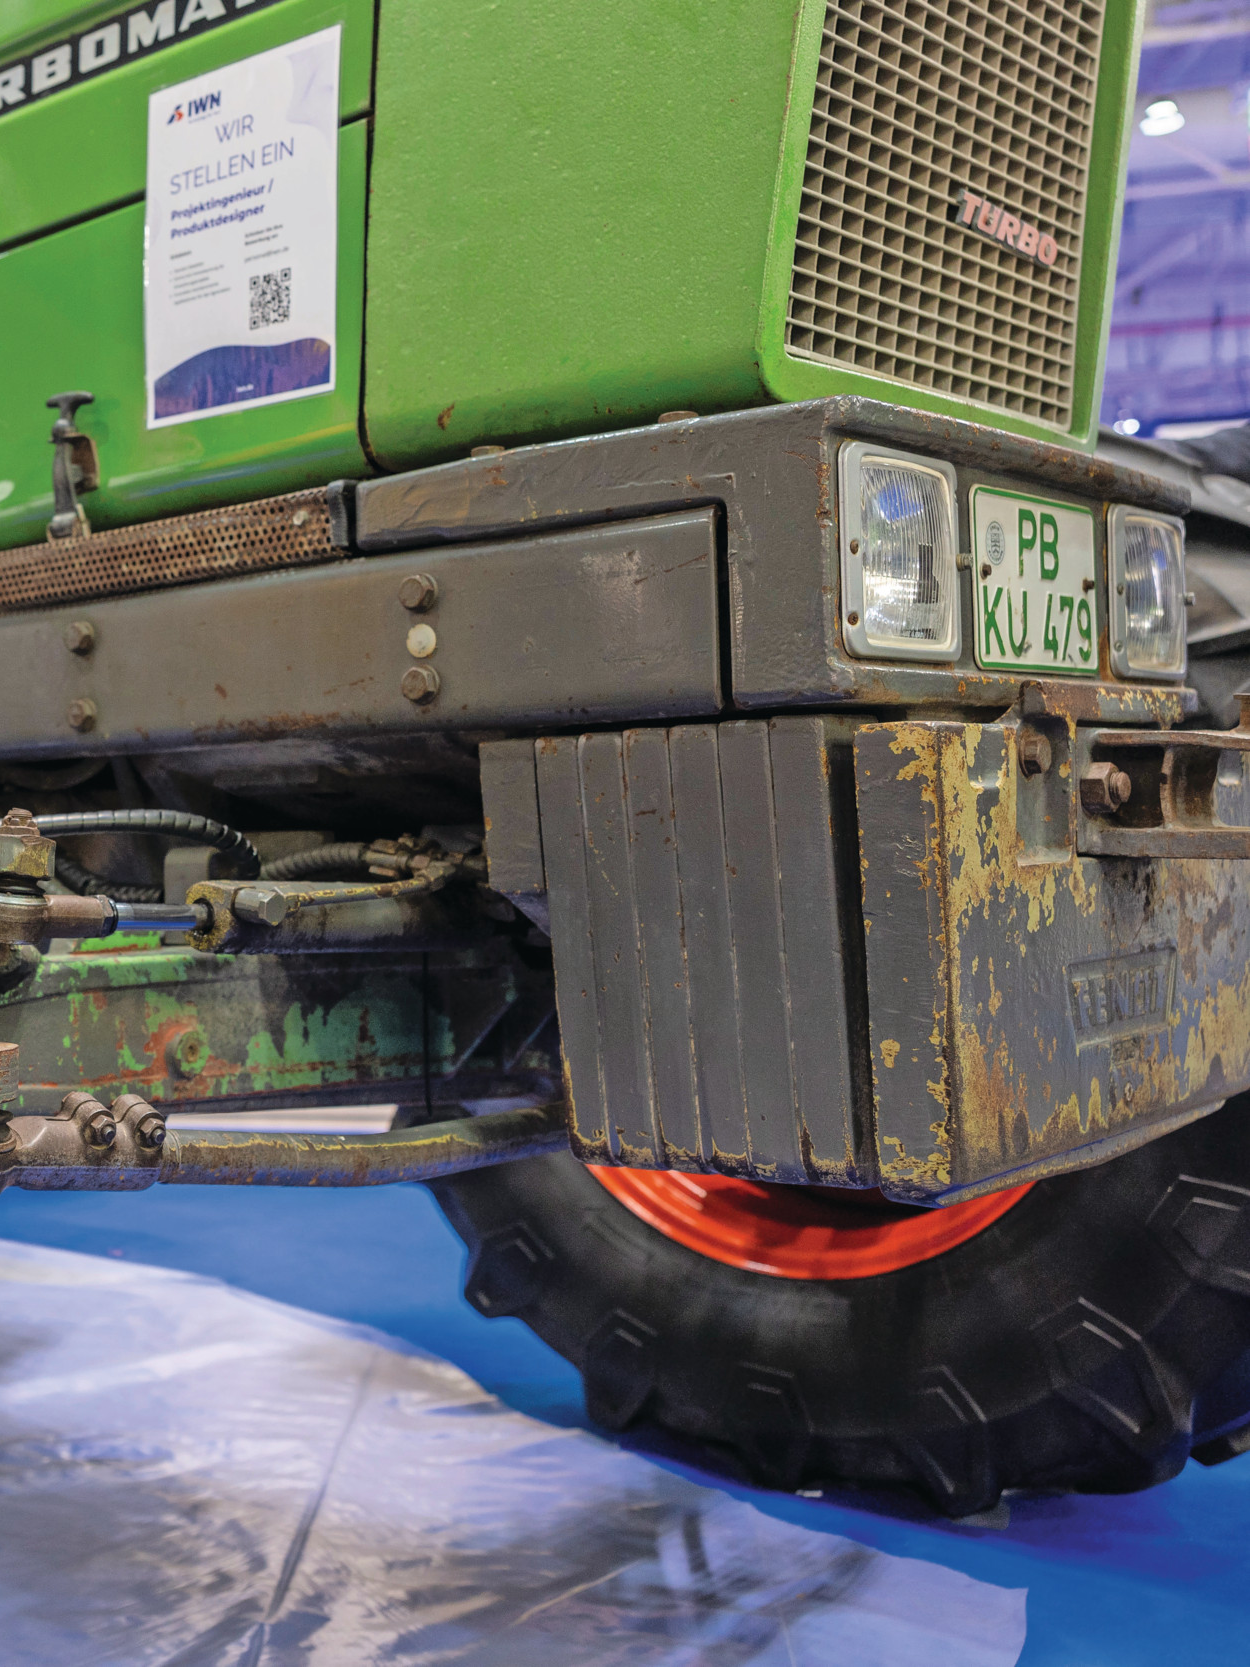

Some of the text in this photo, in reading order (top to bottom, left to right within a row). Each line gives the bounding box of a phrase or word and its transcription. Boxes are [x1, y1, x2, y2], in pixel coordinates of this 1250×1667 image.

[188, 90, 221, 117] IWN
[215, 114, 254, 143] WIR
[170, 136, 294, 195] STELLEN EIN
[171, 184, 266, 221] Projektingenieur
[171, 204, 265, 239] Produktdesigner
[959, 189, 1058, 266] TURBO
[1017, 508, 1059, 581] PB
[982, 585, 1092, 662] KU 479
